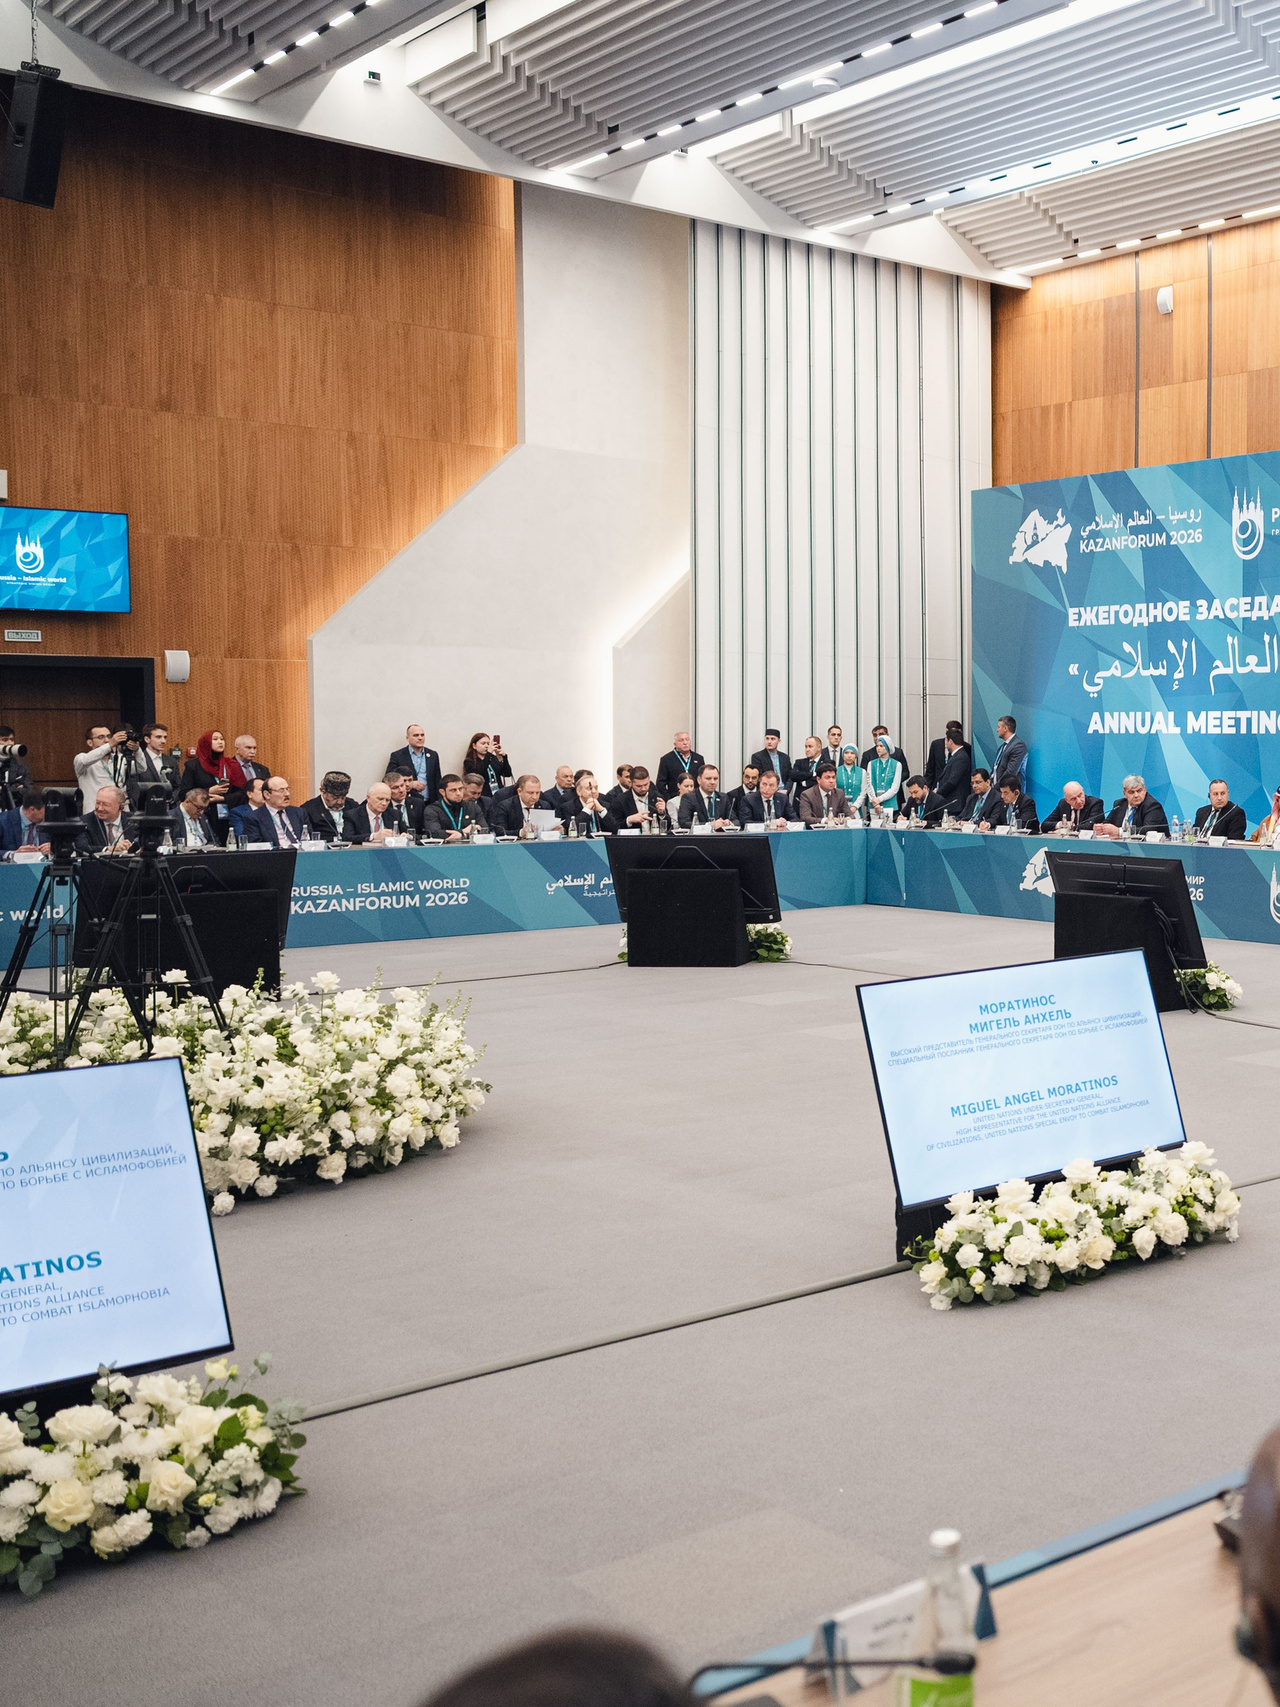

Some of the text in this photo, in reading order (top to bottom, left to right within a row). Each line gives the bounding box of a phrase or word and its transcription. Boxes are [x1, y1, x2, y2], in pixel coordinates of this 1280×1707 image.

[1080, 512, 1124, 538] الإسلامي
[1127, 508, 1153, 534] العالم
[1168, 505, 1202, 525] روسيا
[1080, 529, 1203, 554] KAZANFORUM 2026
[1068, 600, 1191, 628] ЕЖЕГОДНОЕ
[1208, 631, 1279, 696] العالم
[1087, 711, 1180, 735] ANNUAL
[291, 884, 343, 897] RUSSIA
[357, 881, 414, 894] ISLAMIC
[418, 878, 470, 890] WORLD
[546, 873, 595, 895] الإسلامي
[1189, 887, 1204, 902] 26
[291, 892, 469, 915] KAZANFORUM 2026
[979, 994, 1056, 1015] МОРАТИНОС
[969, 1009, 1072, 1034] МИГЕЛЬ АНХЕЛЬ
[950, 1075, 1119, 1118] MIGUEL ANGEL MORATINOS
[19, 1158, 78, 1175] АЛЬЯНСУ
[82, 1144, 178, 1167] ЦИВИЛИЗАЦИЙ,
[20, 1173, 69, 1189] БОРЬБЕ
[73, 1170, 82, 1180] С
[86, 1155, 187, 1178] ИСЛАМОФОБИЕЙ
[0, 1286, 105, 1314] TIONS ALLIANCE
[0, 1287, 171, 1327] TO COMBAT ISLAMOPHOBIA
